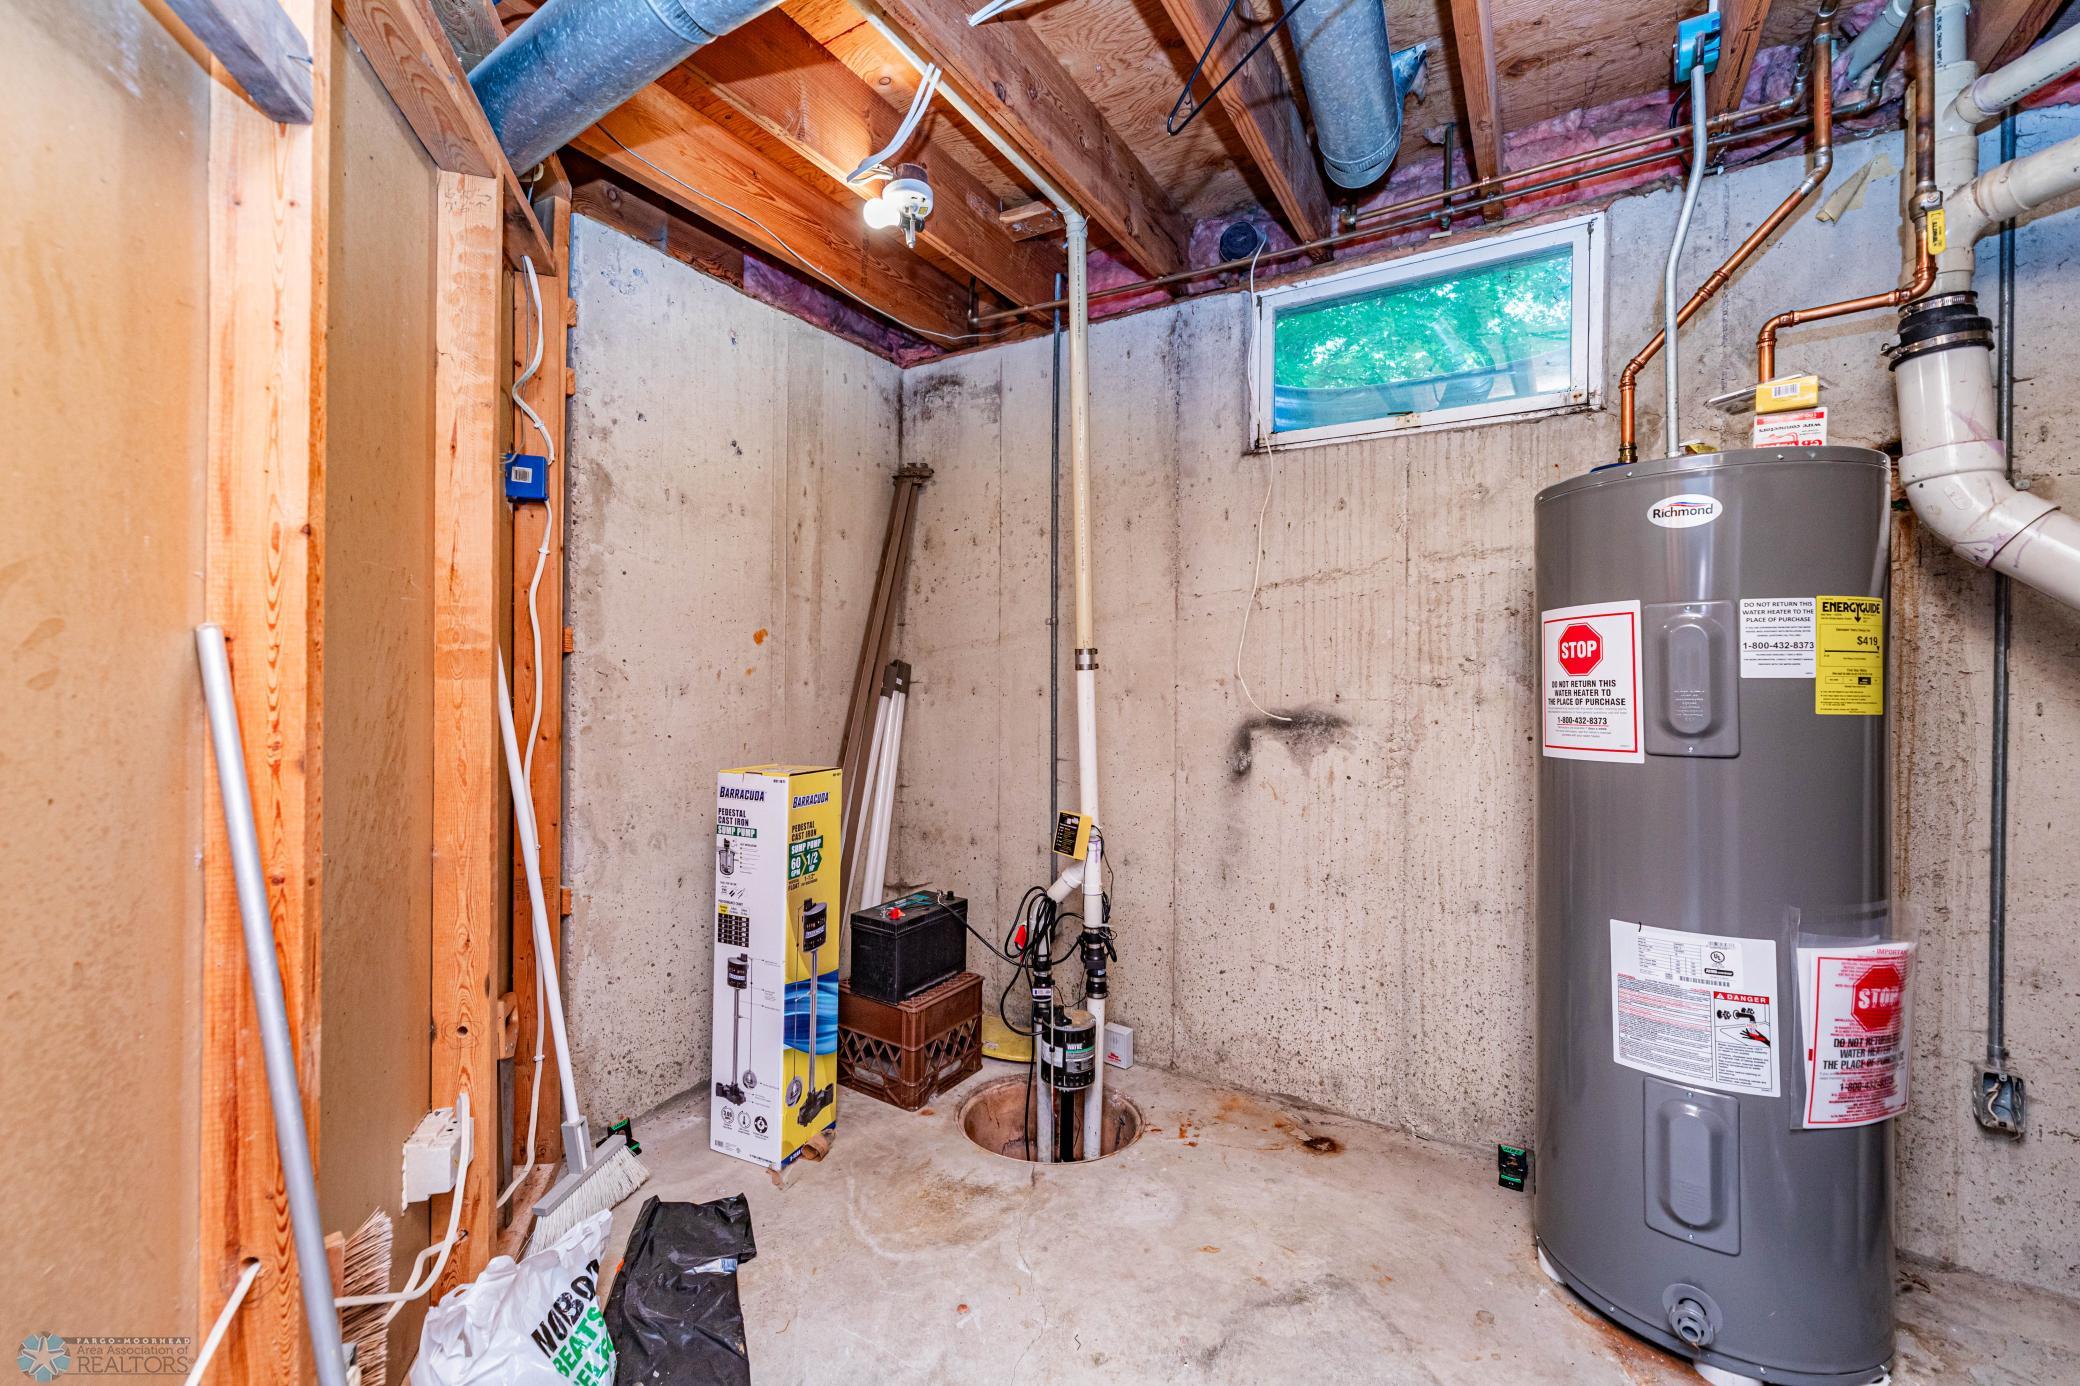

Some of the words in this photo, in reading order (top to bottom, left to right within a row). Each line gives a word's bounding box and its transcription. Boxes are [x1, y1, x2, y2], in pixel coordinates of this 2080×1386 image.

[1652, 503, 1713, 519] Richmond
[1822, 601, 1880, 614] ENERGYGUIDE
[1857, 636, 1878, 646] $419
[1561, 640, 1598, 660] STOP
[1552, 680, 1558, 688] DO
[1559, 680, 1569, 688] NOT
[1571, 680, 1596, 688] RETURN
[1599, 679, 1616, 687] THIS
[1573, 689, 1599, 697] HEATER
[1548, 698, 1556, 706] THE
[1557, 698, 1574, 706] PLACE
[1575, 698, 1583, 706] OF
[1585, 698, 1626, 706] PURCHASE
[1557, 717, 1608, 725] 1-800-432-8373
[720, 787, 765, 802] BARRACUDA
[792, 792, 830, 808] BARRACUDA
[718, 808, 746, 818] PEDESTAL
[718, 816, 733, 825] CAST
[734, 818, 749, 827] IRON
[791, 820, 815, 833] PEDESTAL
[718, 825, 736, 836] SUMP
[736, 827, 756, 838] PUMP
[792, 832, 804, 842] CAST
[806, 829, 817, 838] IRON
[791, 842, 806, 854] SUMP
[806, 838, 822, 850] PUMP
[791, 857, 801, 870] 60
[806, 851, 818, 866] 1/2
[1726, 994, 1766, 1003] DANGER
[1833, 1038, 1846, 1048] DO
[1848, 1038, 1864, 1048] NOT
[1840, 1049, 1866, 1059] WATER
[1823, 1060, 1839, 1070] THE
[1841, 1059, 1864, 1070] PLACE
[552, 1306, 605, 1378] BEATS
